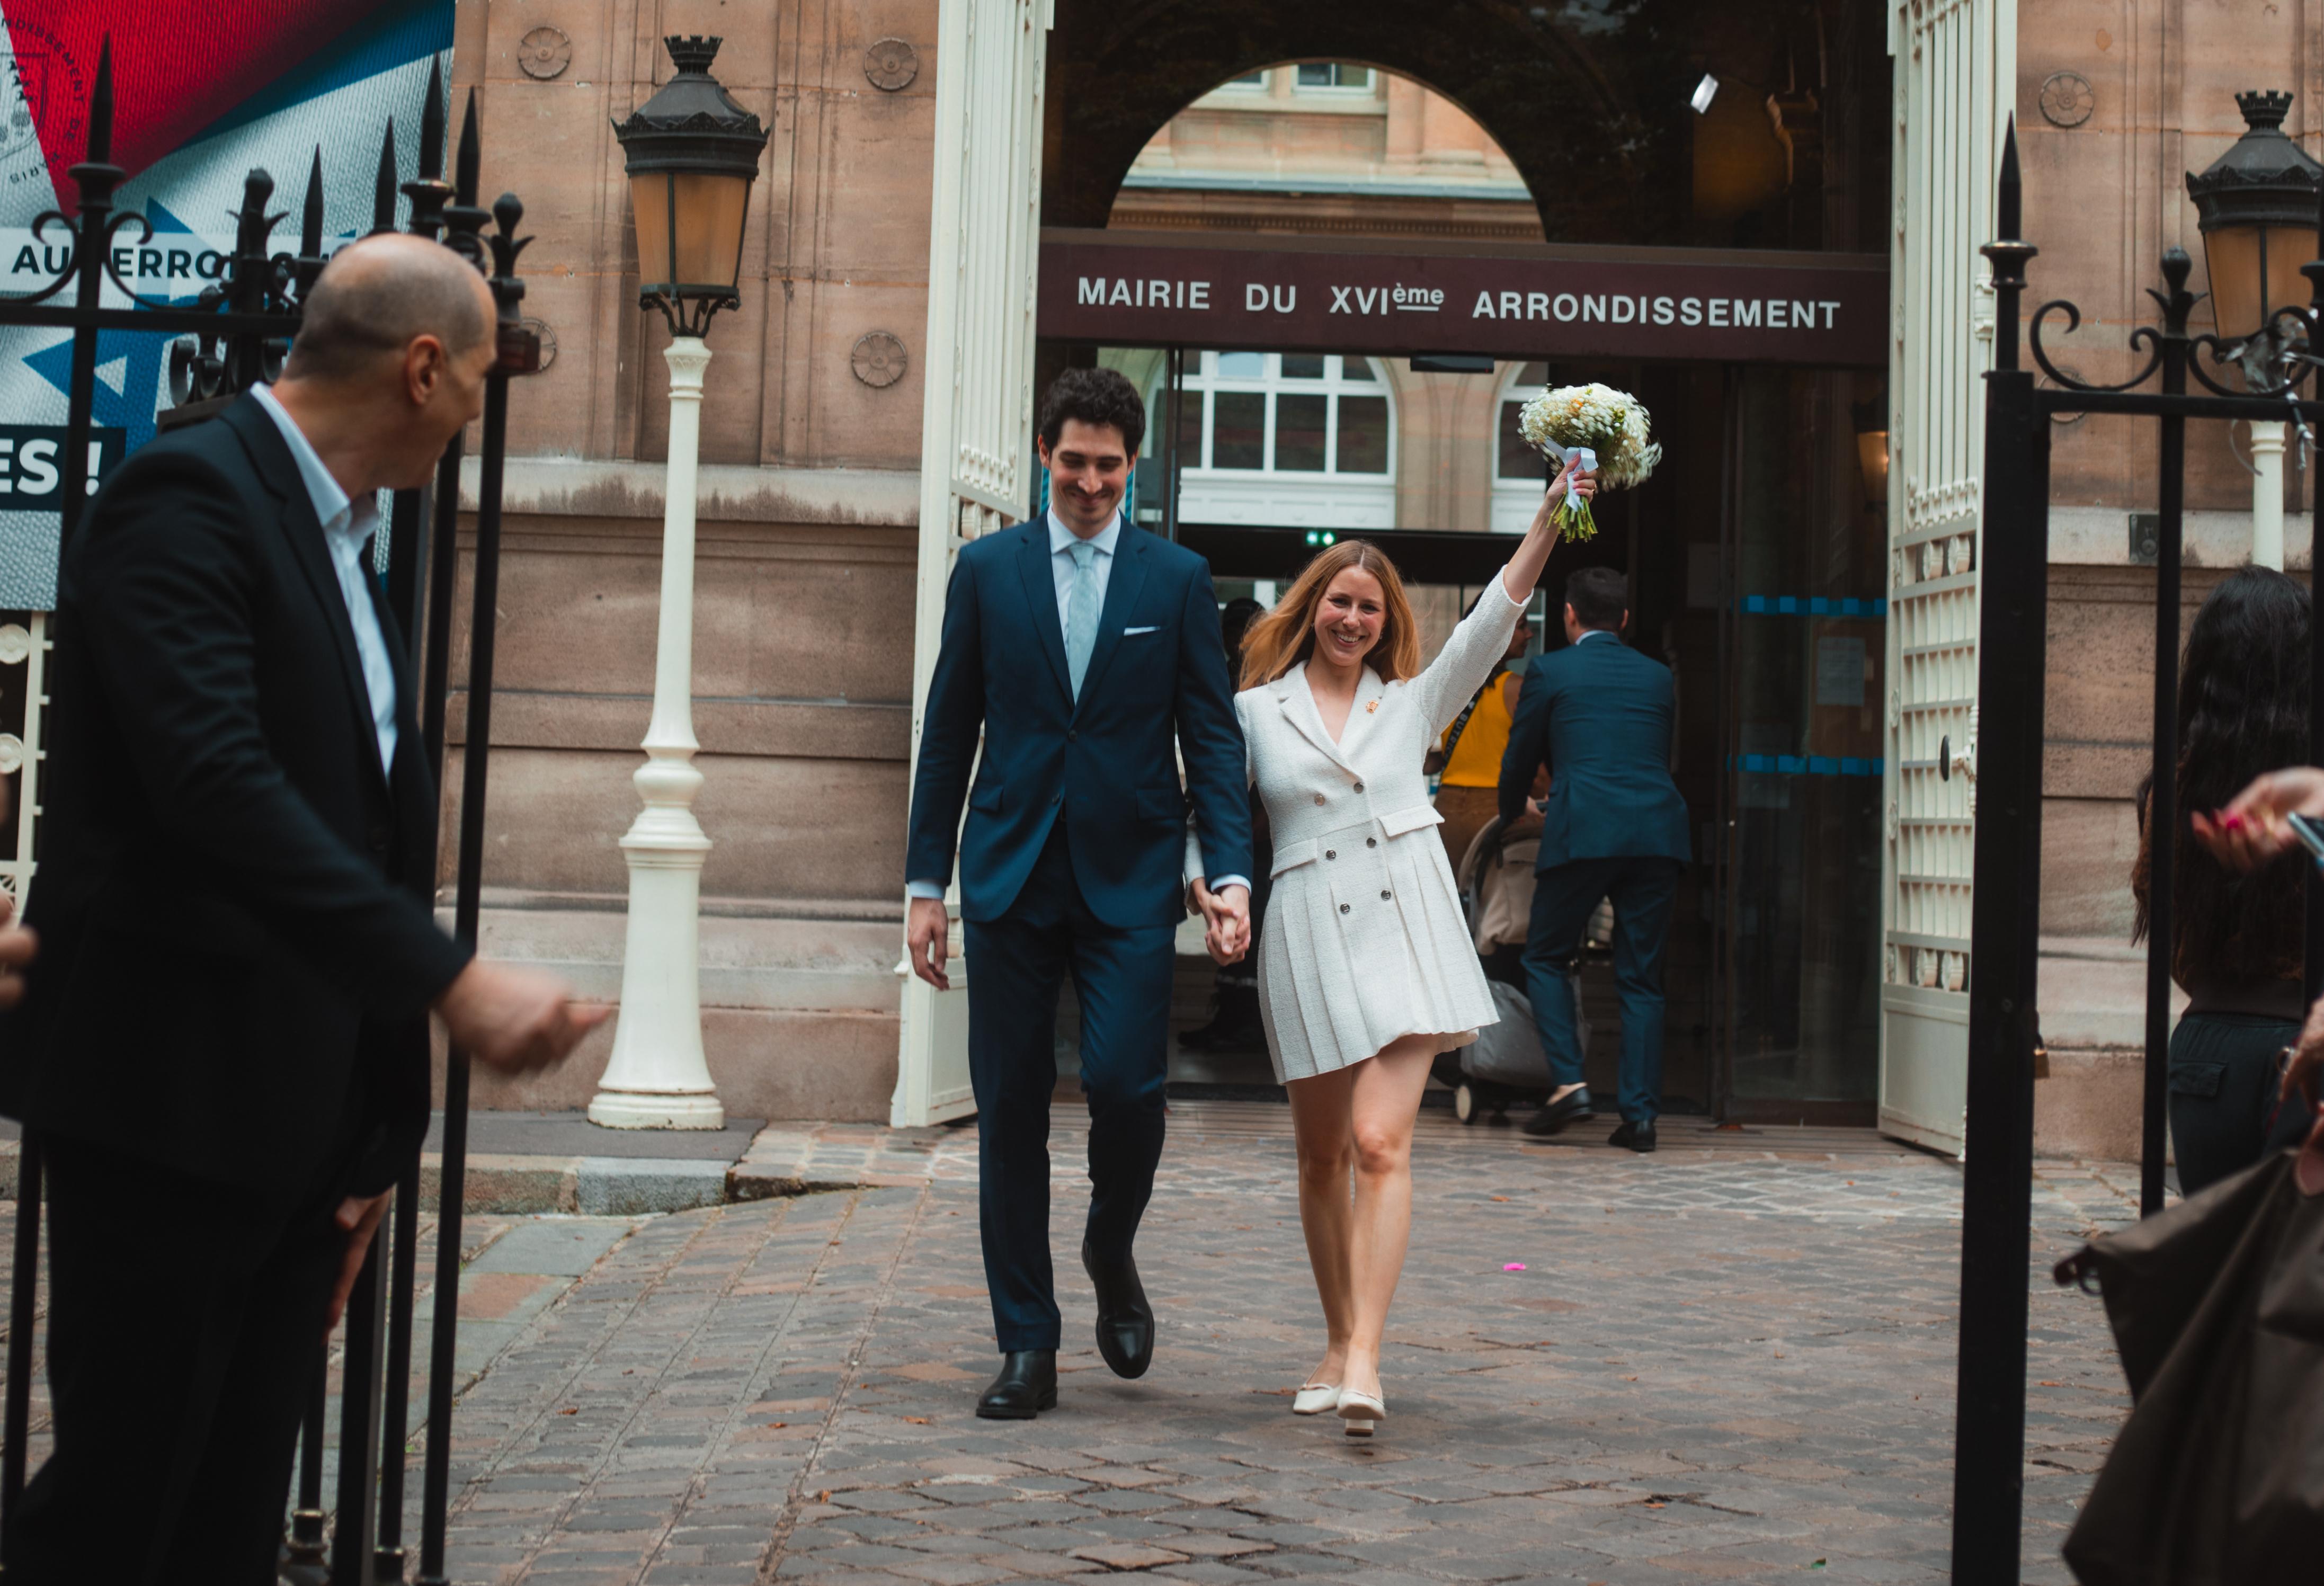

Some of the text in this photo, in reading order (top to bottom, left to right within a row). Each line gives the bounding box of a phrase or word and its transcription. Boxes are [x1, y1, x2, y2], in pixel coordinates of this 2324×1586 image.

[11, 245, 70, 275] AU
[1078, 277, 1841, 329] MAIRIE DU XVIème ARRONDISSEMENT
